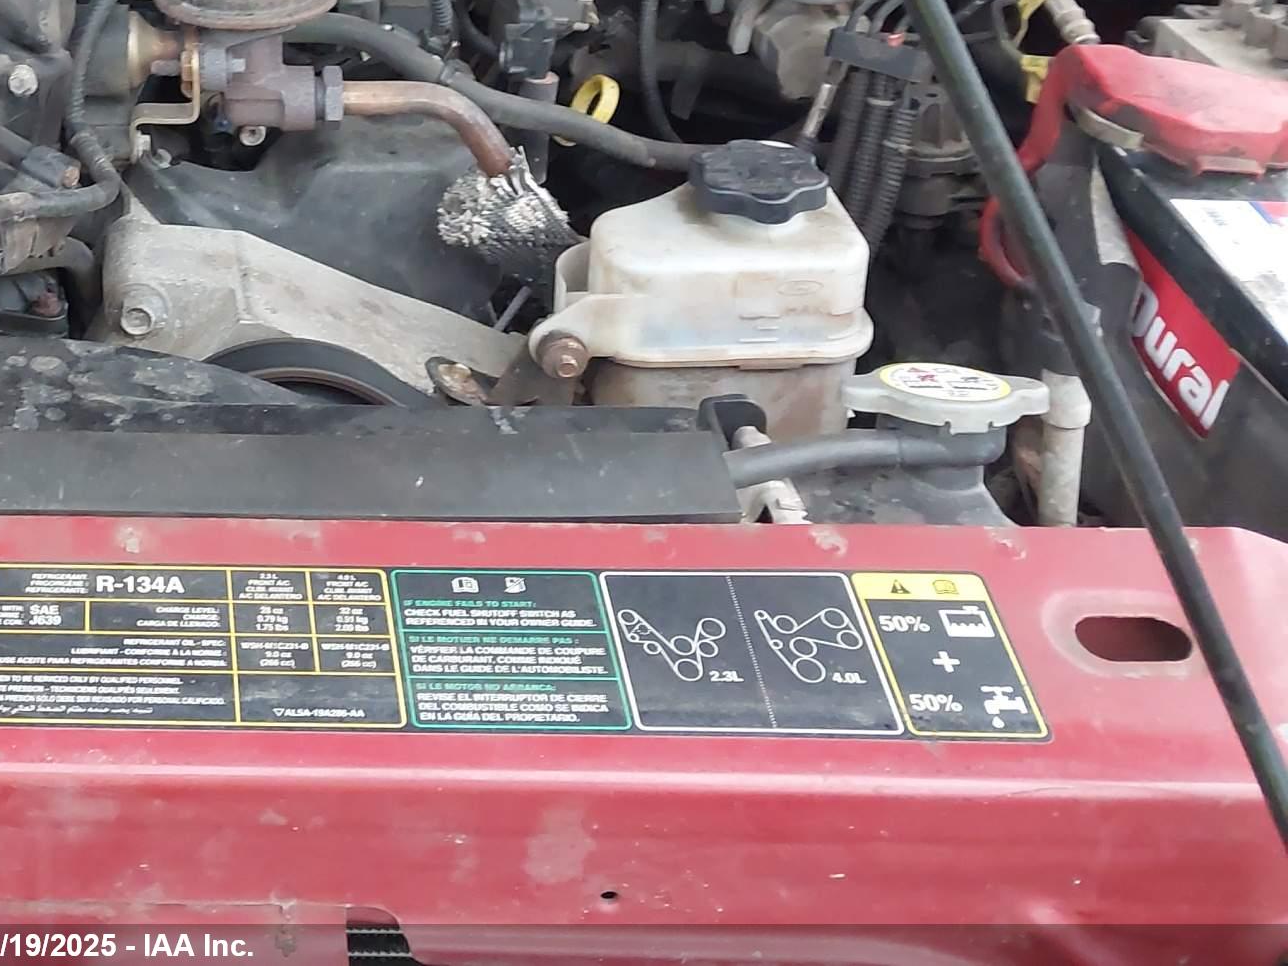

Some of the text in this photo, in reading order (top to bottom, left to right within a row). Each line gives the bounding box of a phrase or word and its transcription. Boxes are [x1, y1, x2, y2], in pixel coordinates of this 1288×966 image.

[96, 576, 185, 594] R-134A
[29, 604, 60, 615] SAE
[404, 609, 441, 617] CHECK
[470, 610, 518, 618] SHUTOFF
[28, 614, 62, 626] J639
[406, 618, 475, 626] REFERENCED
[489, 619, 519, 627] YOUR
[878, 615, 930, 632] 50%
[460, 646, 474, 654] LA
[476, 646, 536, 655] COMMANDE
[538, 647, 553, 655] DE
[554, 647, 606, 655] COUPURE
[411, 655, 427, 663] DE
[445, 665, 458, 673] LE
[460, 665, 494, 673] GUIDE
[495, 665, 510, 673] DE
[709, 670, 744, 682] 2.3L
[832, 672, 867, 684] 4.0L
[417, 693, 456, 701] REVISE
[458, 693, 472, 701] EL
[550, 694, 564, 702] DE
[909, 694, 963, 712] 50%
[420, 712, 436, 720] EN
[437, 712, 452, 721] LA
[483, 713, 504, 721] DEL
